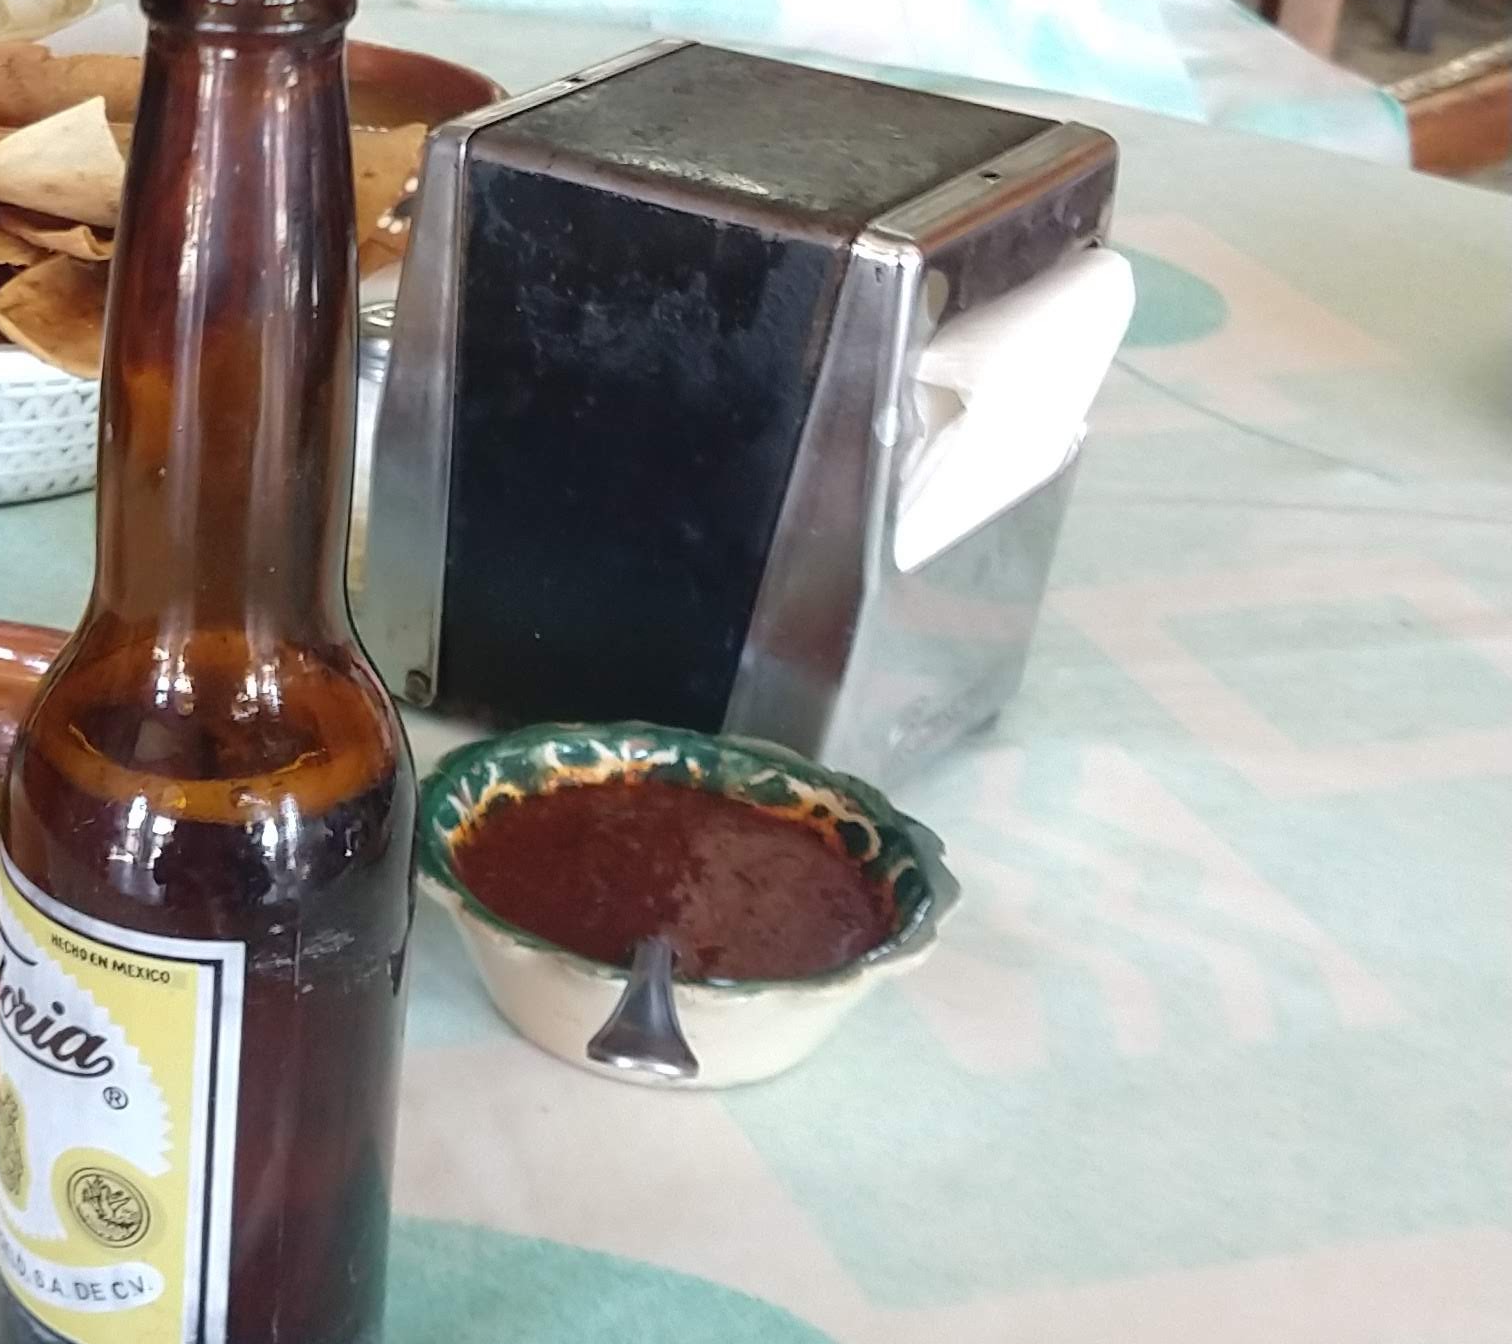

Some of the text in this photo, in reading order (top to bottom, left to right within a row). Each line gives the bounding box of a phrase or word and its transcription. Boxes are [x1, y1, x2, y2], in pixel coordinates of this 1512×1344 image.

[51, 933, 171, 984] HECHO EN MEXICO
[73, 1281, 107, 1302] DE
